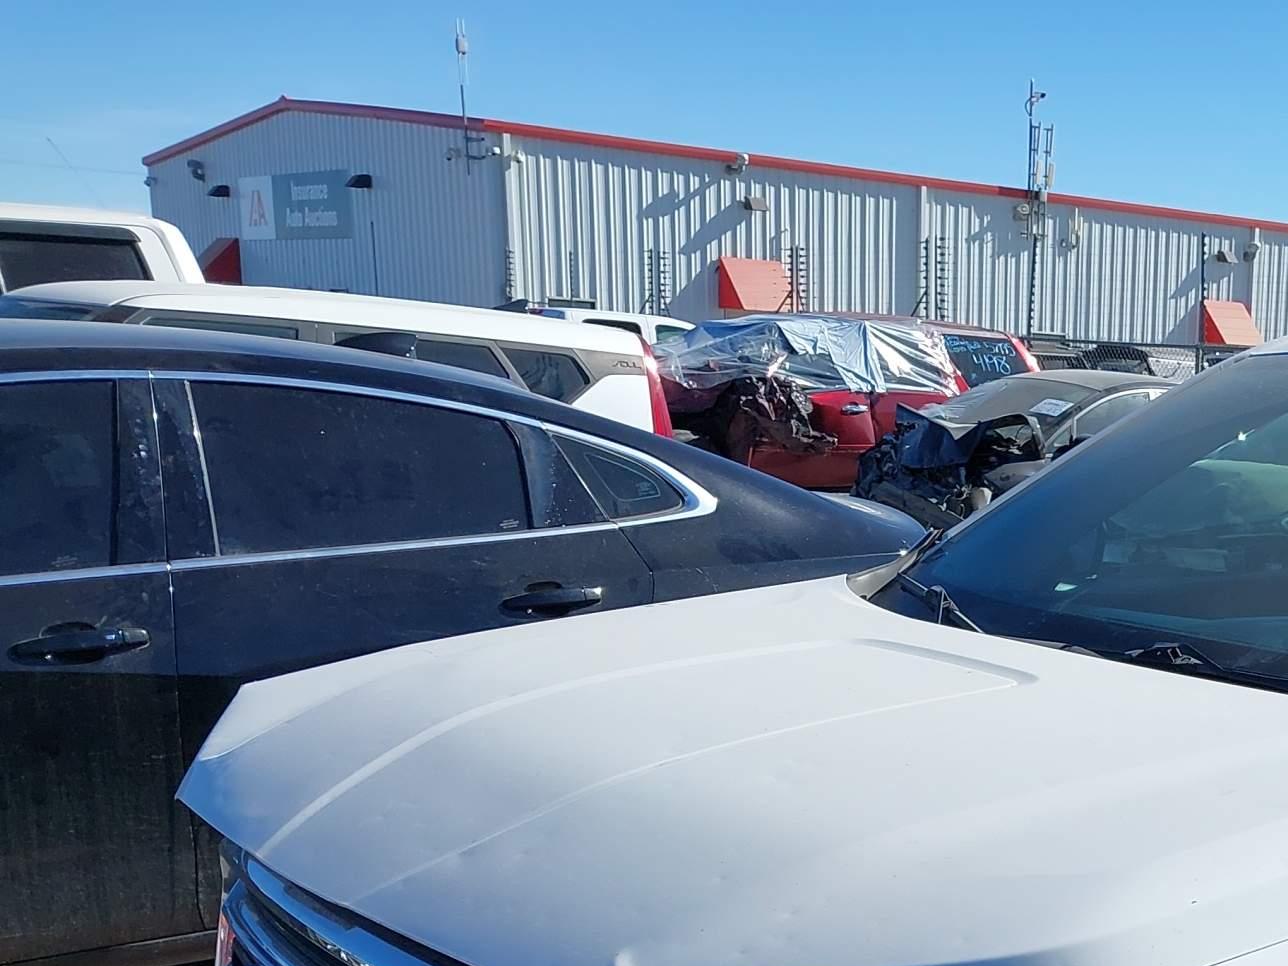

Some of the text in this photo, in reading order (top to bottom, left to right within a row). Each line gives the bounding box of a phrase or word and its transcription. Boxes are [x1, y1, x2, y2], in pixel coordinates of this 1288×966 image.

[290, 180, 328, 201] Insurance
[286, 205, 338, 227] Auto Auctions
